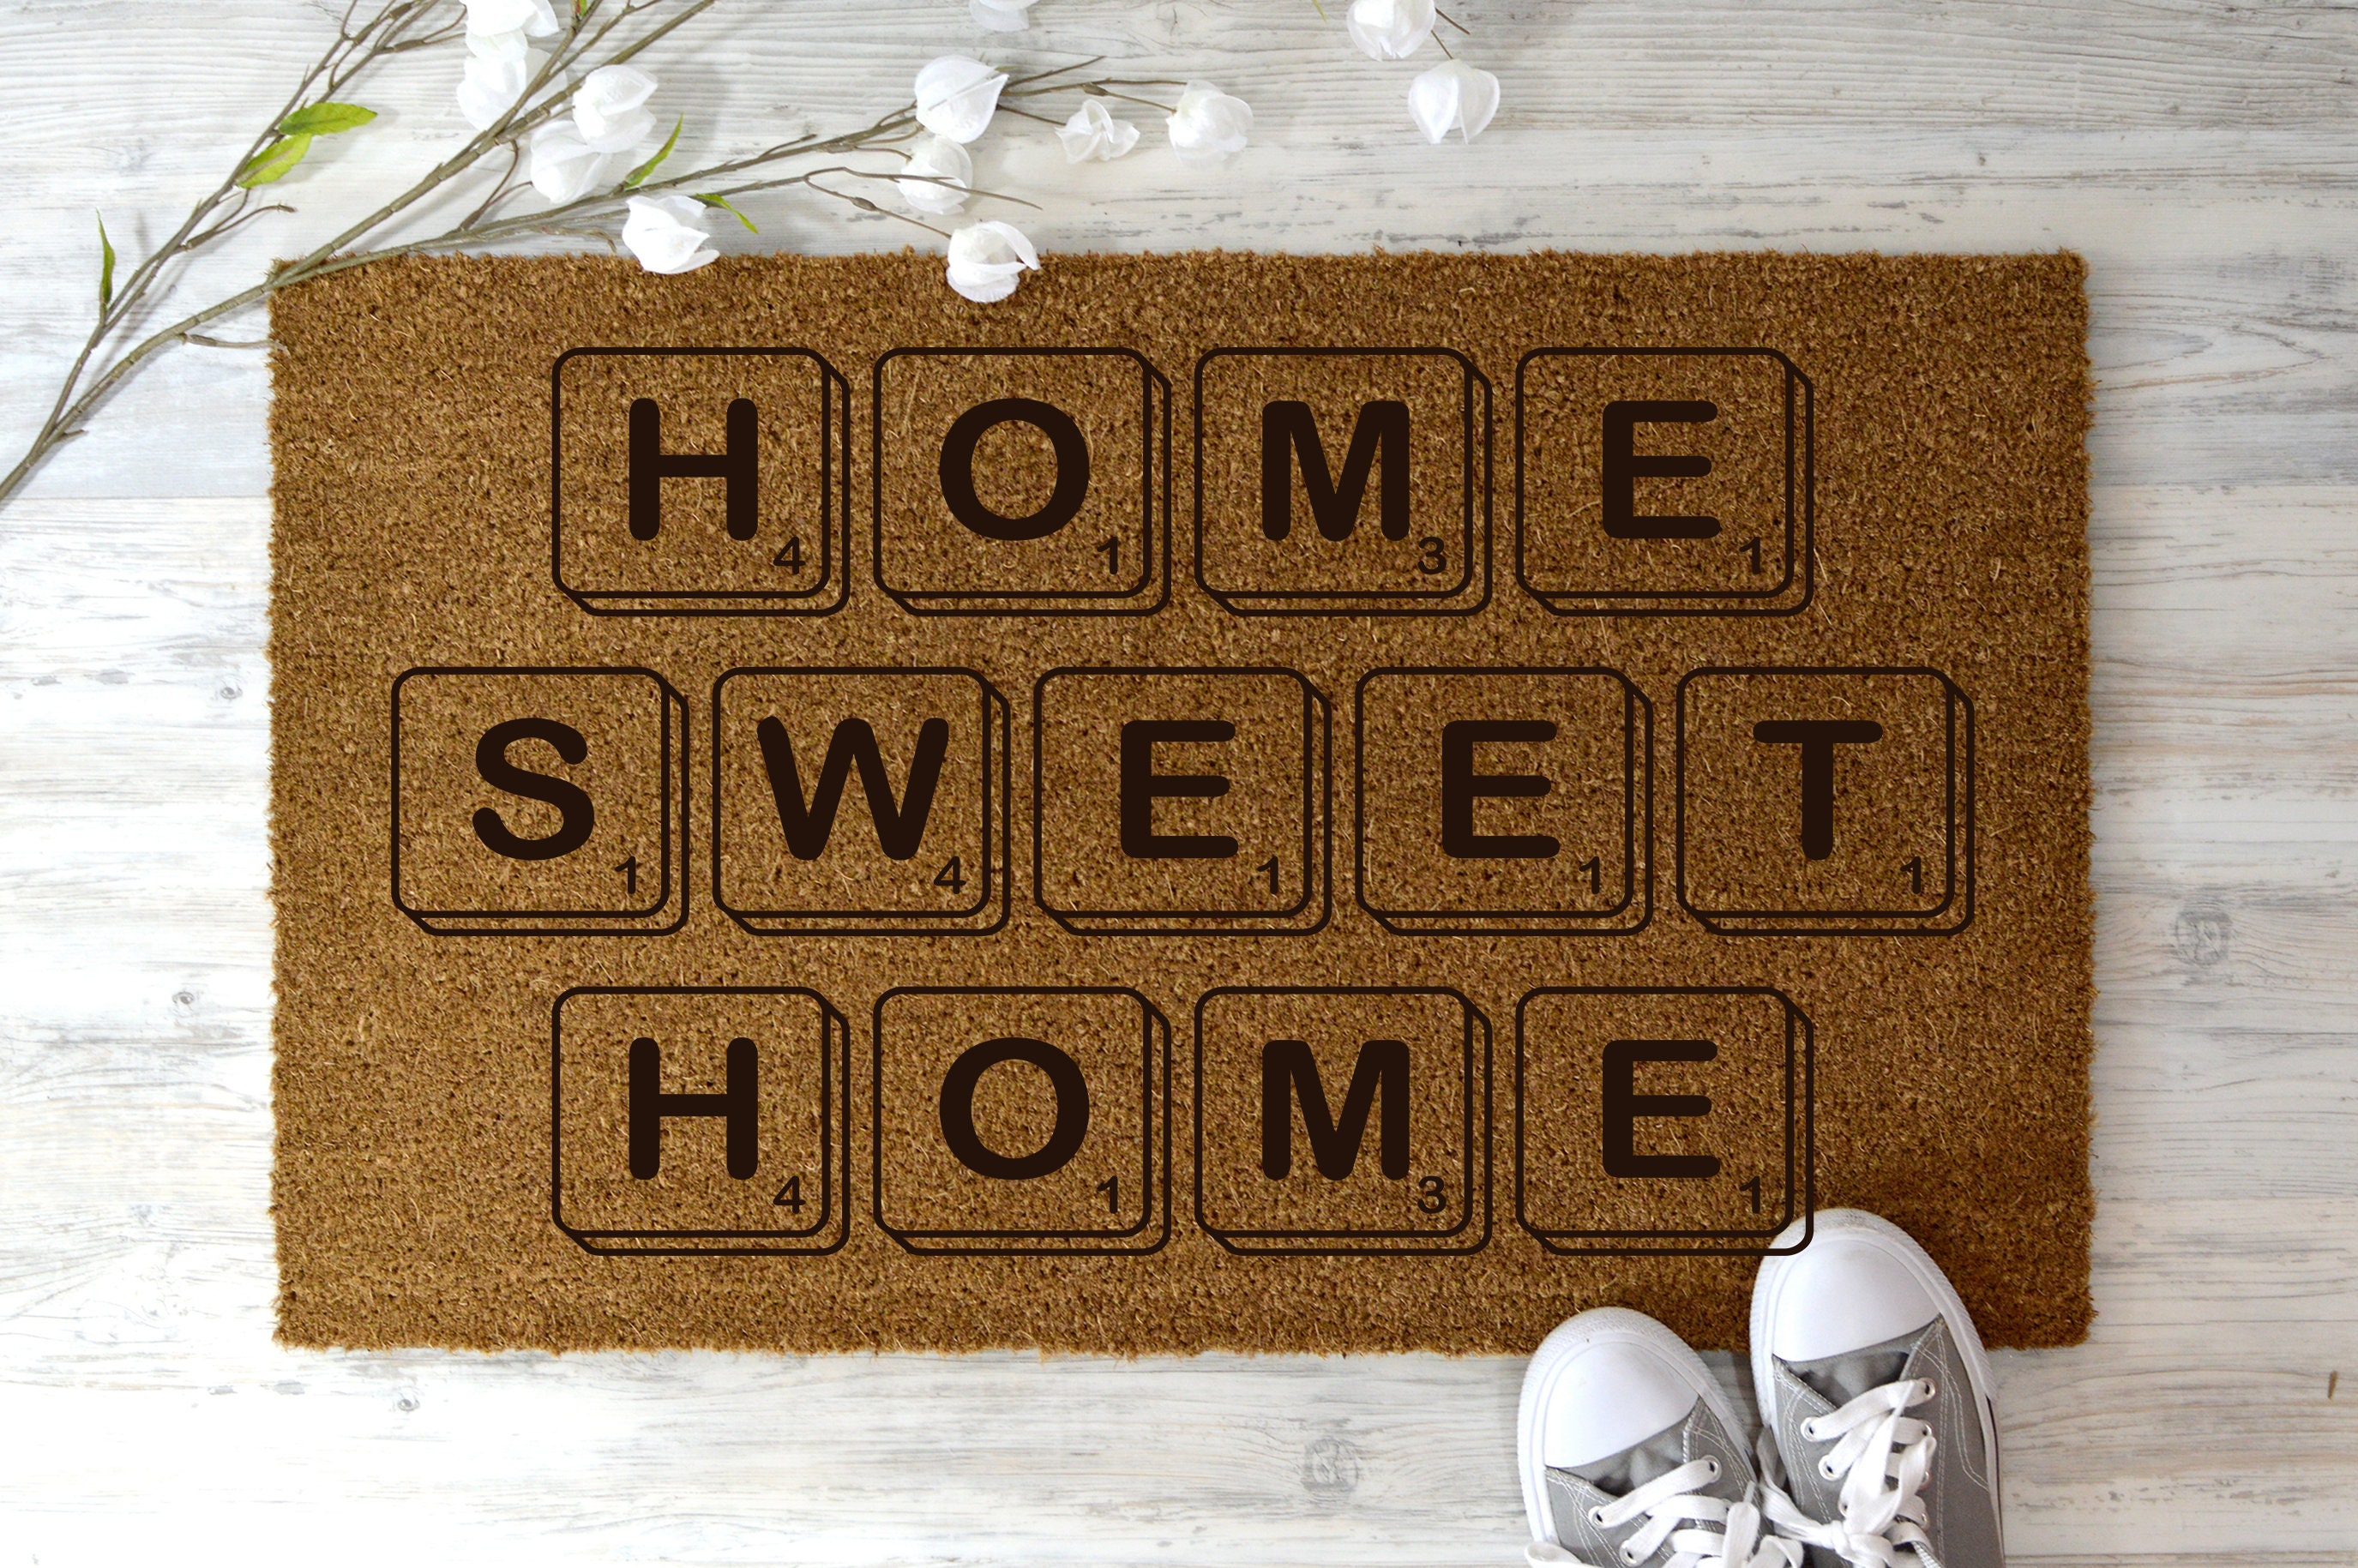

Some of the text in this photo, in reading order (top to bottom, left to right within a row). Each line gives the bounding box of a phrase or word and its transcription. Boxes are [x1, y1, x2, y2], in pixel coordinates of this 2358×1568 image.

[629, 397, 1723, 542] HOME
[773, 536, 1762, 575] 4 1 3 1
[472, 716, 1884, 861] SWEET
[614, 856, 1922, 894] 1 4 1 1 1
[629, 1037, 1723, 1181] HOME
[773, 1175, 1762, 1214] 4 1 3 1
